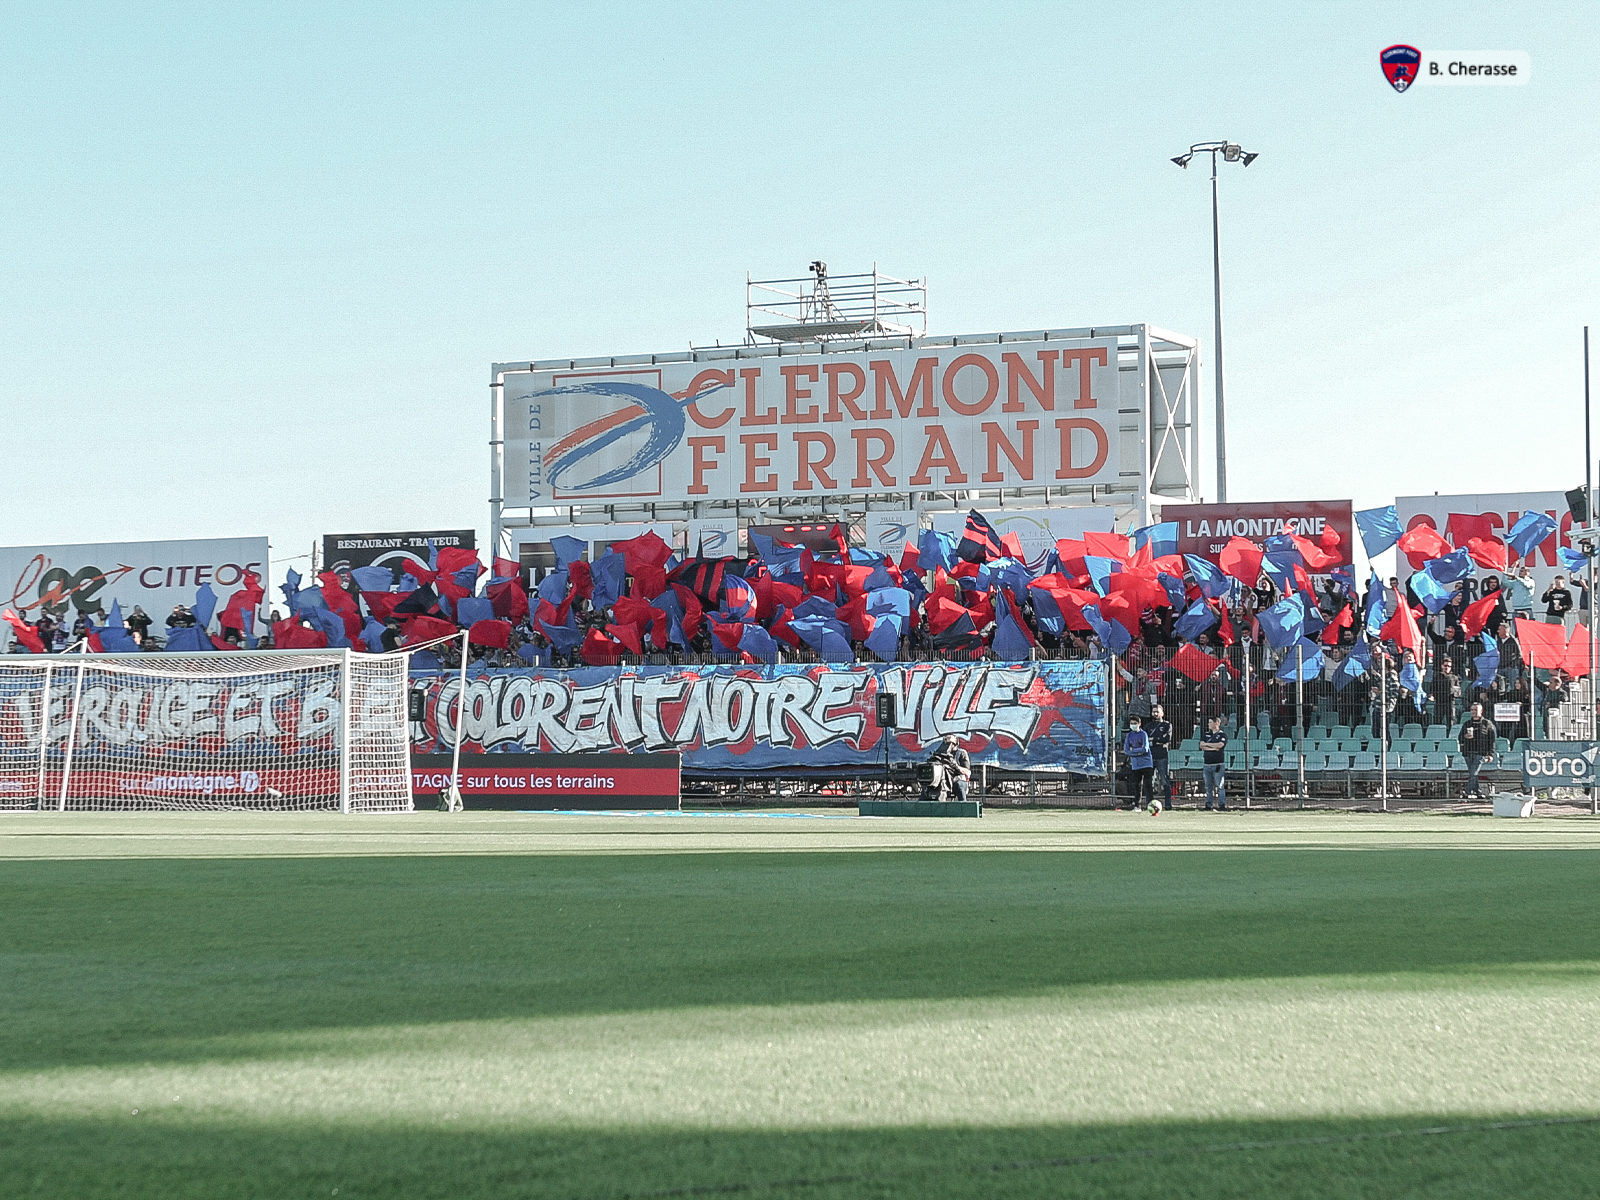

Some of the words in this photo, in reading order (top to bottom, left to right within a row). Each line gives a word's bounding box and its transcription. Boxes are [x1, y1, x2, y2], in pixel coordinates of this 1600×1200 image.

[687, 346, 1108, 430] CLERMONT
[529, 403, 541, 430] DE
[687, 416, 1110, 495] FERRAND
[529, 441, 541, 502] VILLE
[1186, 519, 1212, 538] LA
[337, 539, 402, 549] RESTAURANT
[409, 536, 460, 547] TRATEUR
[139, 562, 262, 589] CITEOS
[226, 677, 297, 742] ET
[436, 675, 684, 752] COLORENT
[673, 669, 872, 751] NOTRE
[881, 665, 1043, 754] VILLE
[1525, 750, 1587, 776] buro
[466, 776, 491, 788] sur
[494, 774, 526, 788] tous
[530, 773, 552, 788] les
[556, 773, 615, 788] terrains
